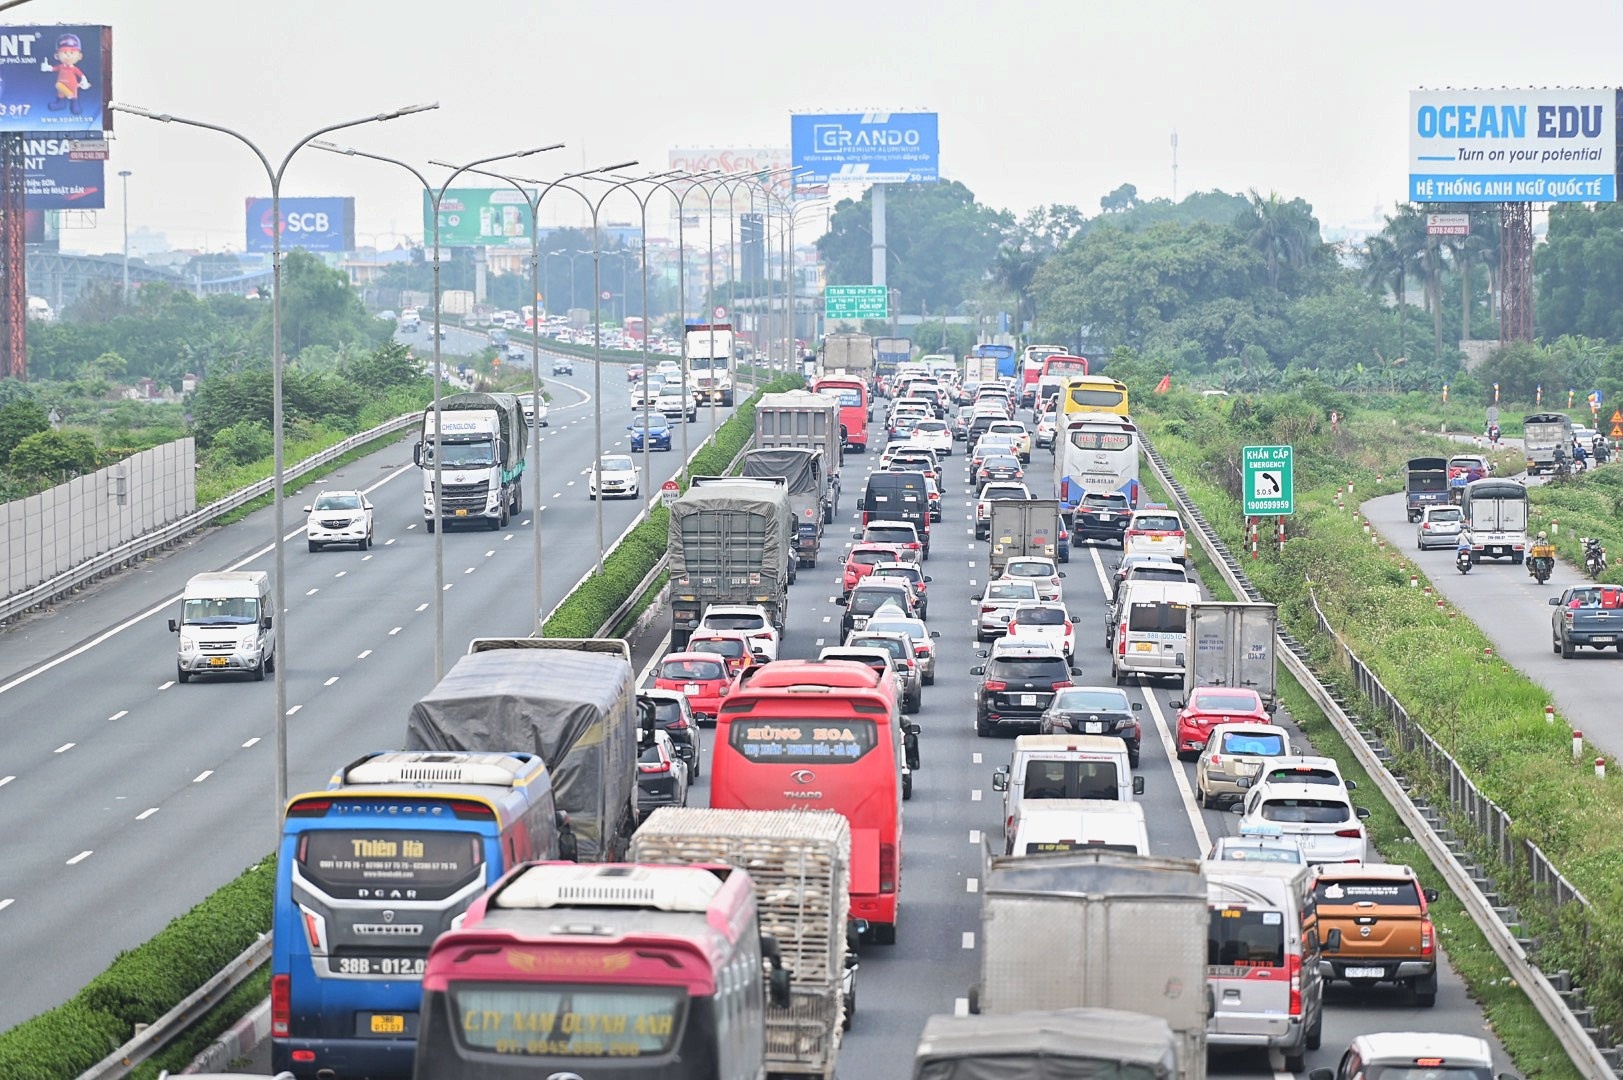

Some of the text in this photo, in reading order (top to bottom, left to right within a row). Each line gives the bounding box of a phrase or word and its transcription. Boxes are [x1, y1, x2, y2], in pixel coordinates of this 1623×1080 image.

[1418, 105, 1603, 138] OCEAN EDU
[823, 129, 920, 146] GRANDO
[1458, 148, 1602, 163] Turn on your potential
[1416, 177, 1603, 198] HỆ THỐNG ANH NGỮ QUỐC TẾ
[287, 211, 329, 232] SCB
[747, 725, 855, 740] HÙNG HOA
[352, 839, 424, 858] Thiên Hà
[340, 958, 370, 974] 38B
[382, 959, 428, 974] 012.0
[634, 1014, 673, 1035] ANH
